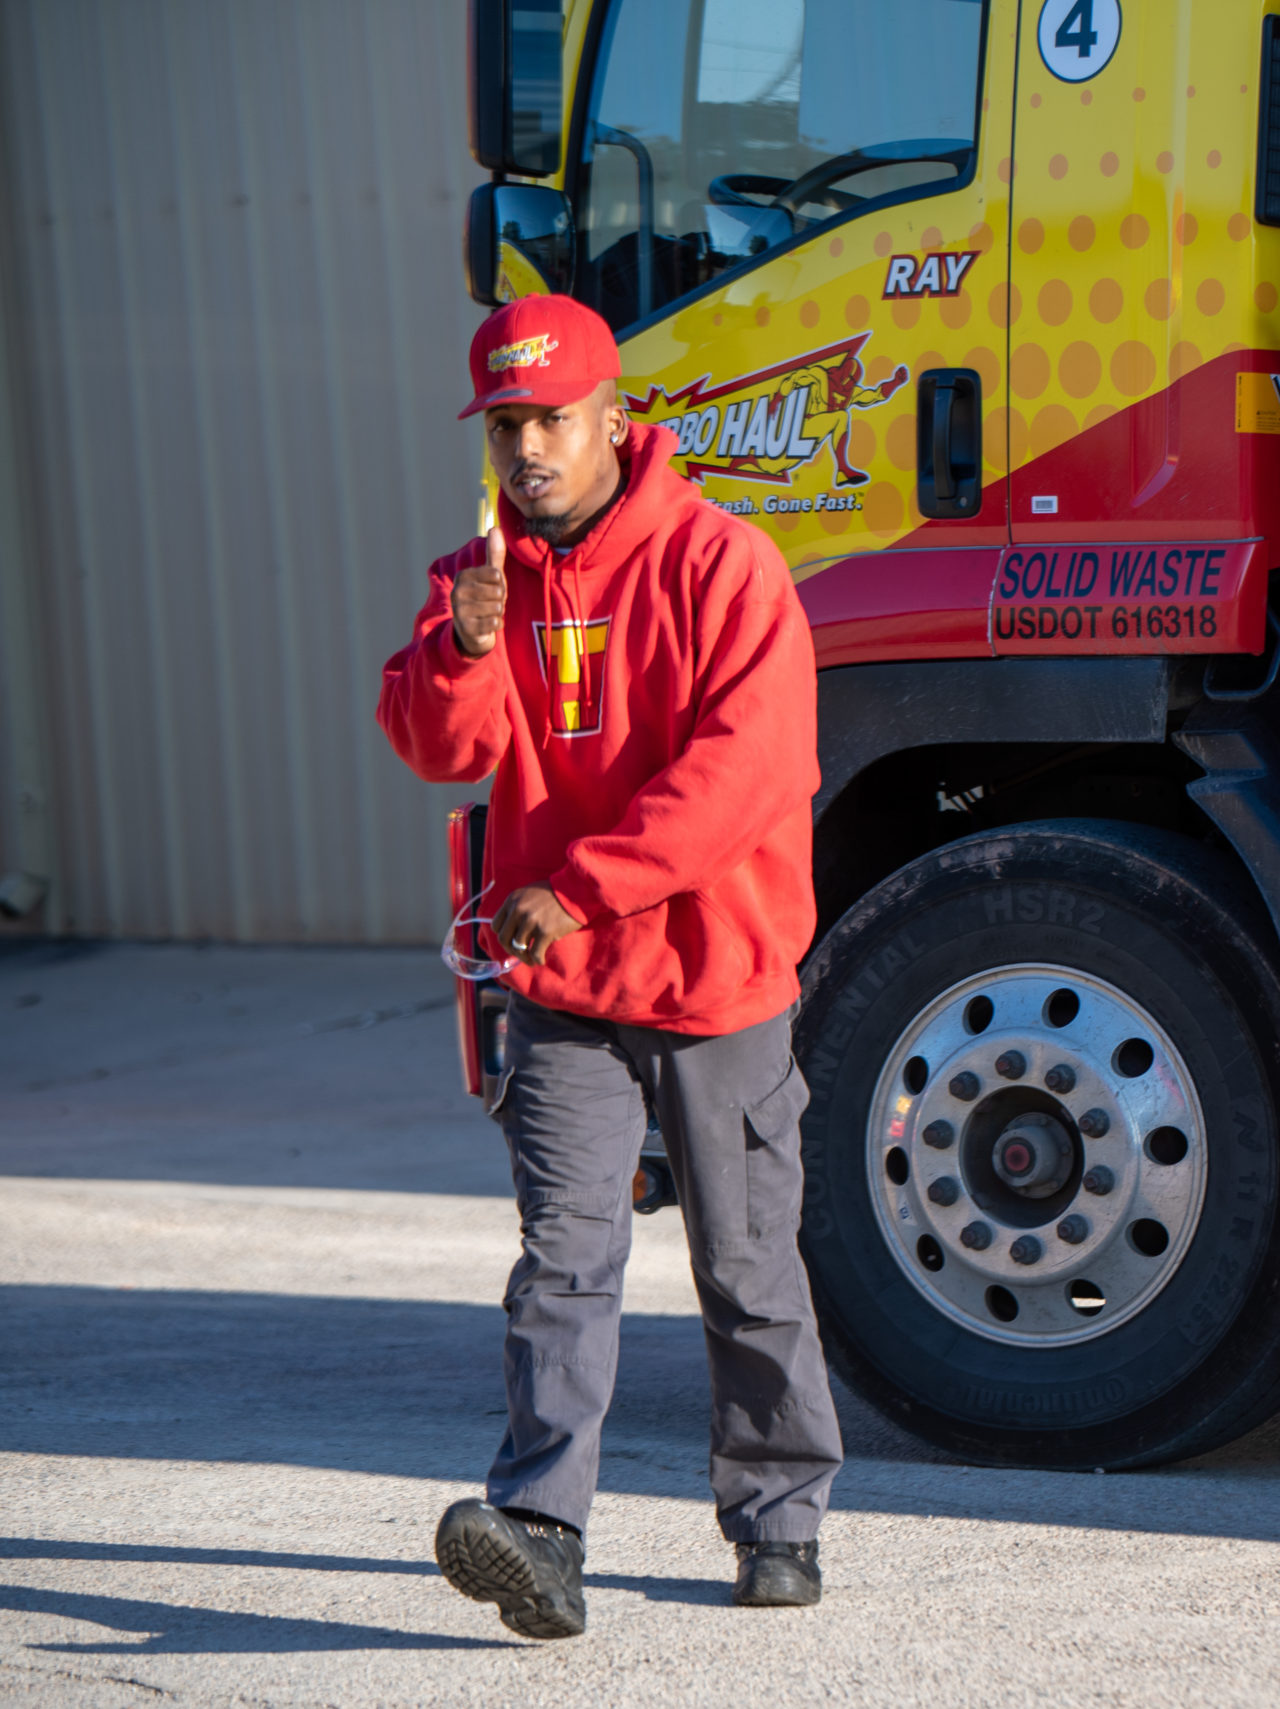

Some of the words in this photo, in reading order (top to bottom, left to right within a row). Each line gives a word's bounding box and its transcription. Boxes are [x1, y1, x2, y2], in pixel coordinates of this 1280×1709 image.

[1055, 0, 1098, 58] 4
[883, 252, 980, 299] RAY
[716, 386, 818, 459] HAUL
[763, 495, 812, 514] Gone
[1000, 551, 1099, 599] SOLID
[1109, 549, 1226, 597] WASTE
[995, 606, 1103, 640] USDOT
[1111, 604, 1217, 639] 616318
[984, 886, 1105, 934] HSR2
